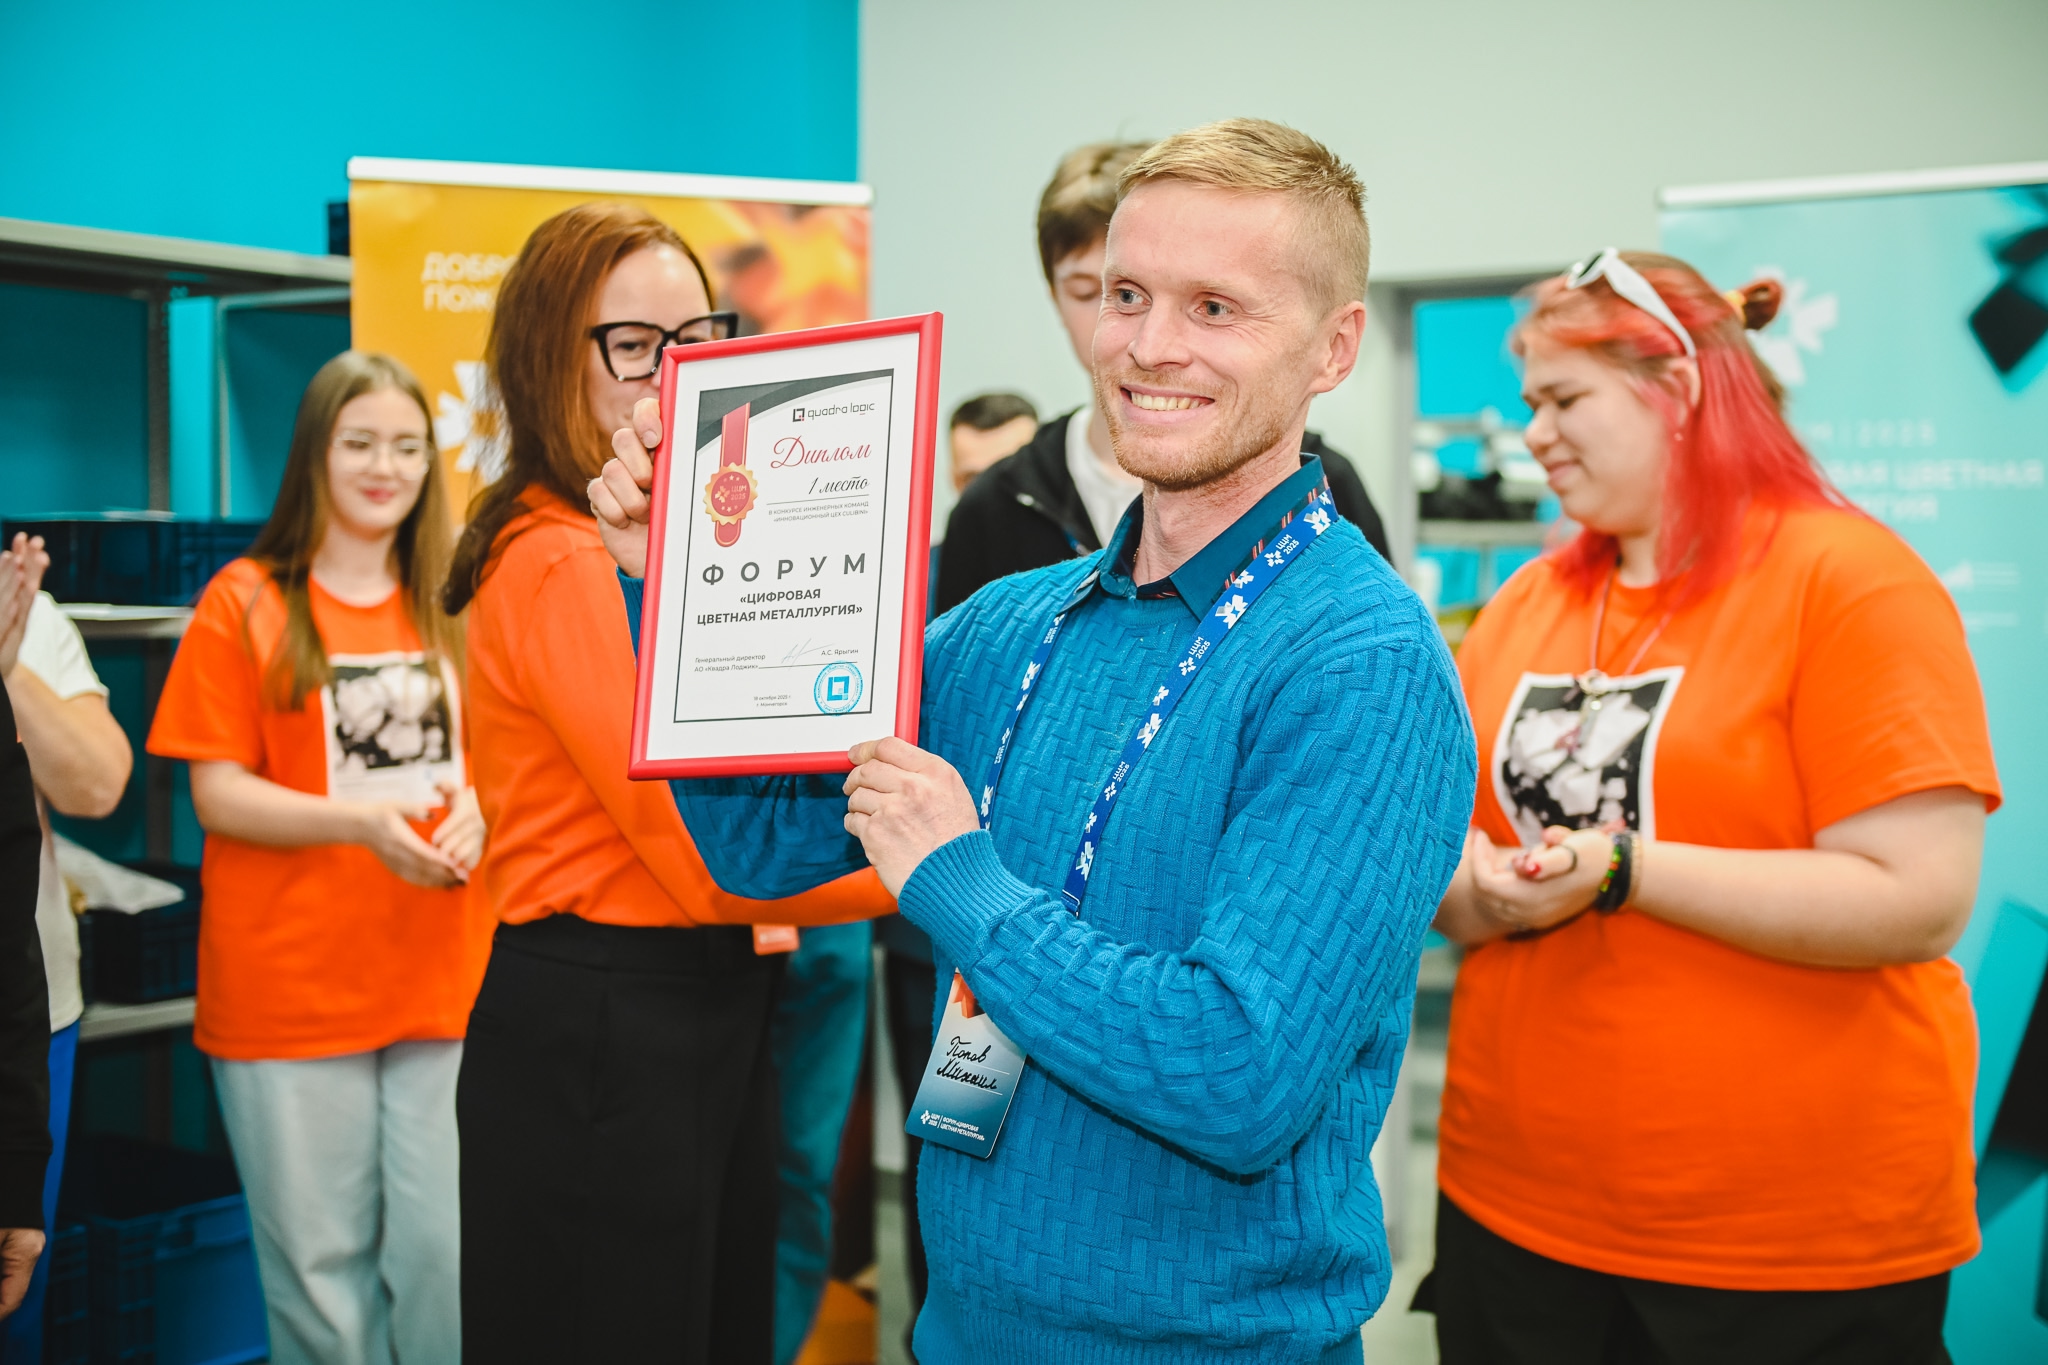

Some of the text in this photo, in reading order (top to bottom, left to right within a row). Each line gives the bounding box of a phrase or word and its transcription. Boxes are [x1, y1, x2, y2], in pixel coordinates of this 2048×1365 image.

[808, 404, 848, 420] quadra
[770, 435, 872, 469] Диплом
[819, 476, 870, 494] место
[773, 507, 803, 515] КОНКУРСЕ
[803, 504, 843, 513] ИНЖЕНЕРНЫХ
[844, 501, 869, 509] КОМАНД
[830, 511, 842, 519] ЦЕХ
[1275, 533, 1293, 551] ЦЦМ
[1283, 538, 1300, 555] 2025
[702, 552, 866, 586] ФОРУМ
[739, 588, 821, 605] «ЦИФРОВАЯ
[697, 604, 863, 626] ЦВЕТНАЯ МЕТАЛЛУРГИЯ»
[834, 648, 859, 656] Ярыгин
[1188, 636, 1204, 656] ЦЦМ
[1195, 641, 1211, 660] 2025
[695, 653, 766, 664] Генеральный директор
[1112, 761, 1126, 780] ЦЦМ
[1116, 763, 1130, 783] 2025
